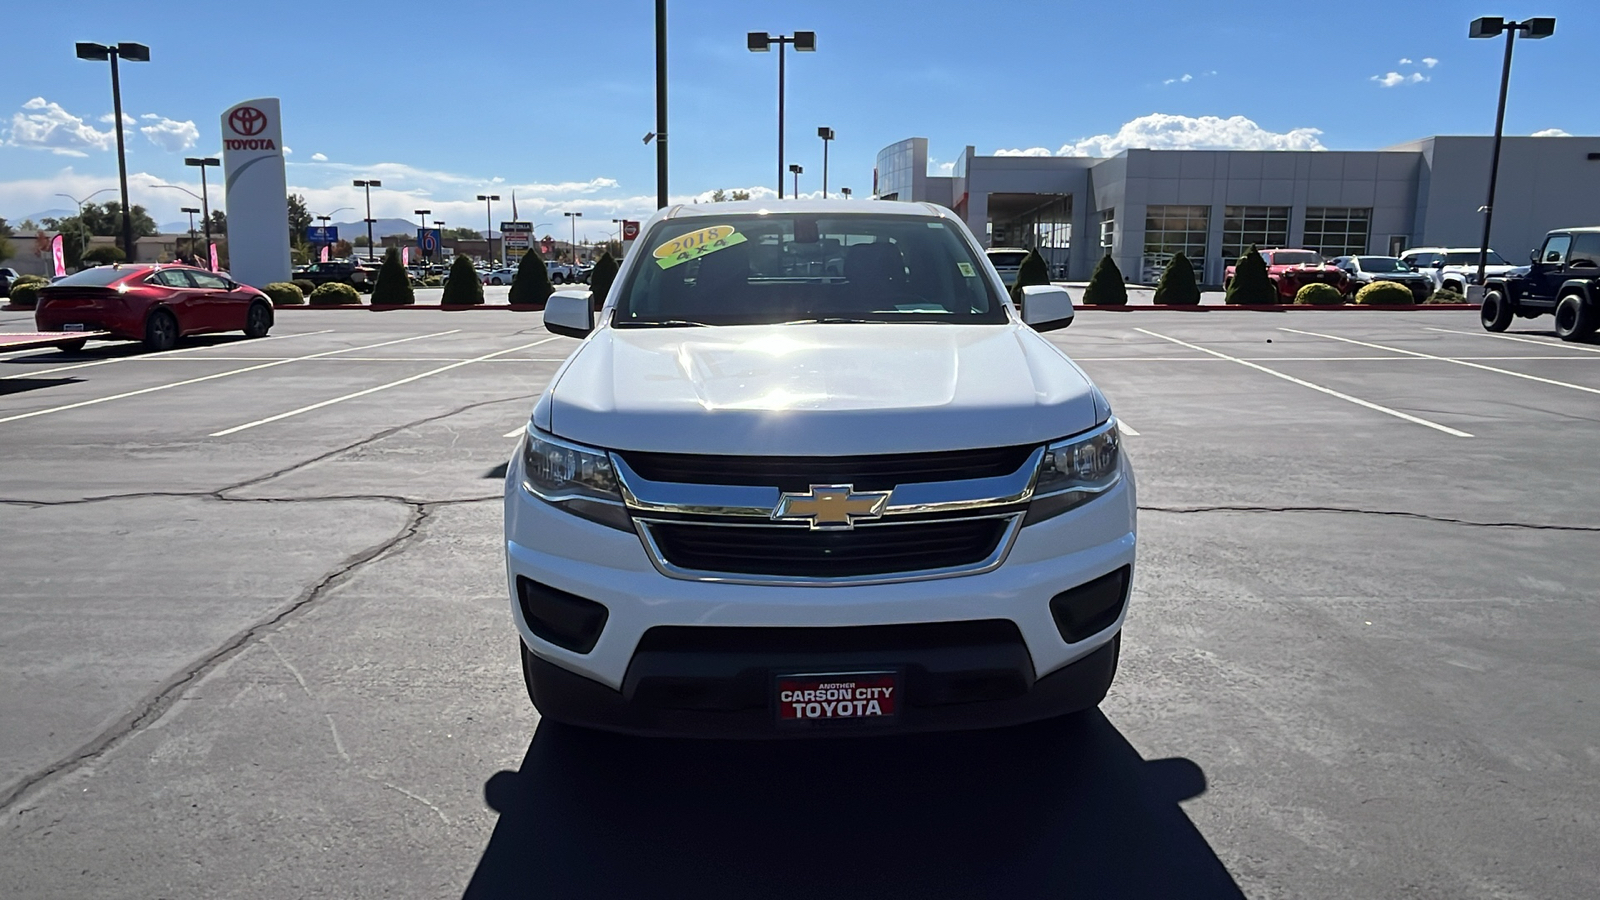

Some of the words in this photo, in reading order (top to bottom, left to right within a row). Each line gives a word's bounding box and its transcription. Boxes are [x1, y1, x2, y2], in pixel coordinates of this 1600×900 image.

[224, 139, 276, 150] TOYOTA
[423, 230, 437, 251] 6
[671, 228, 719, 255] 2018
[818, 682, 856, 690] ANOTHER
[781, 689, 852, 702] CARSON
[855, 687, 893, 700] CITY
[792, 700, 882, 718] TOYOTA
